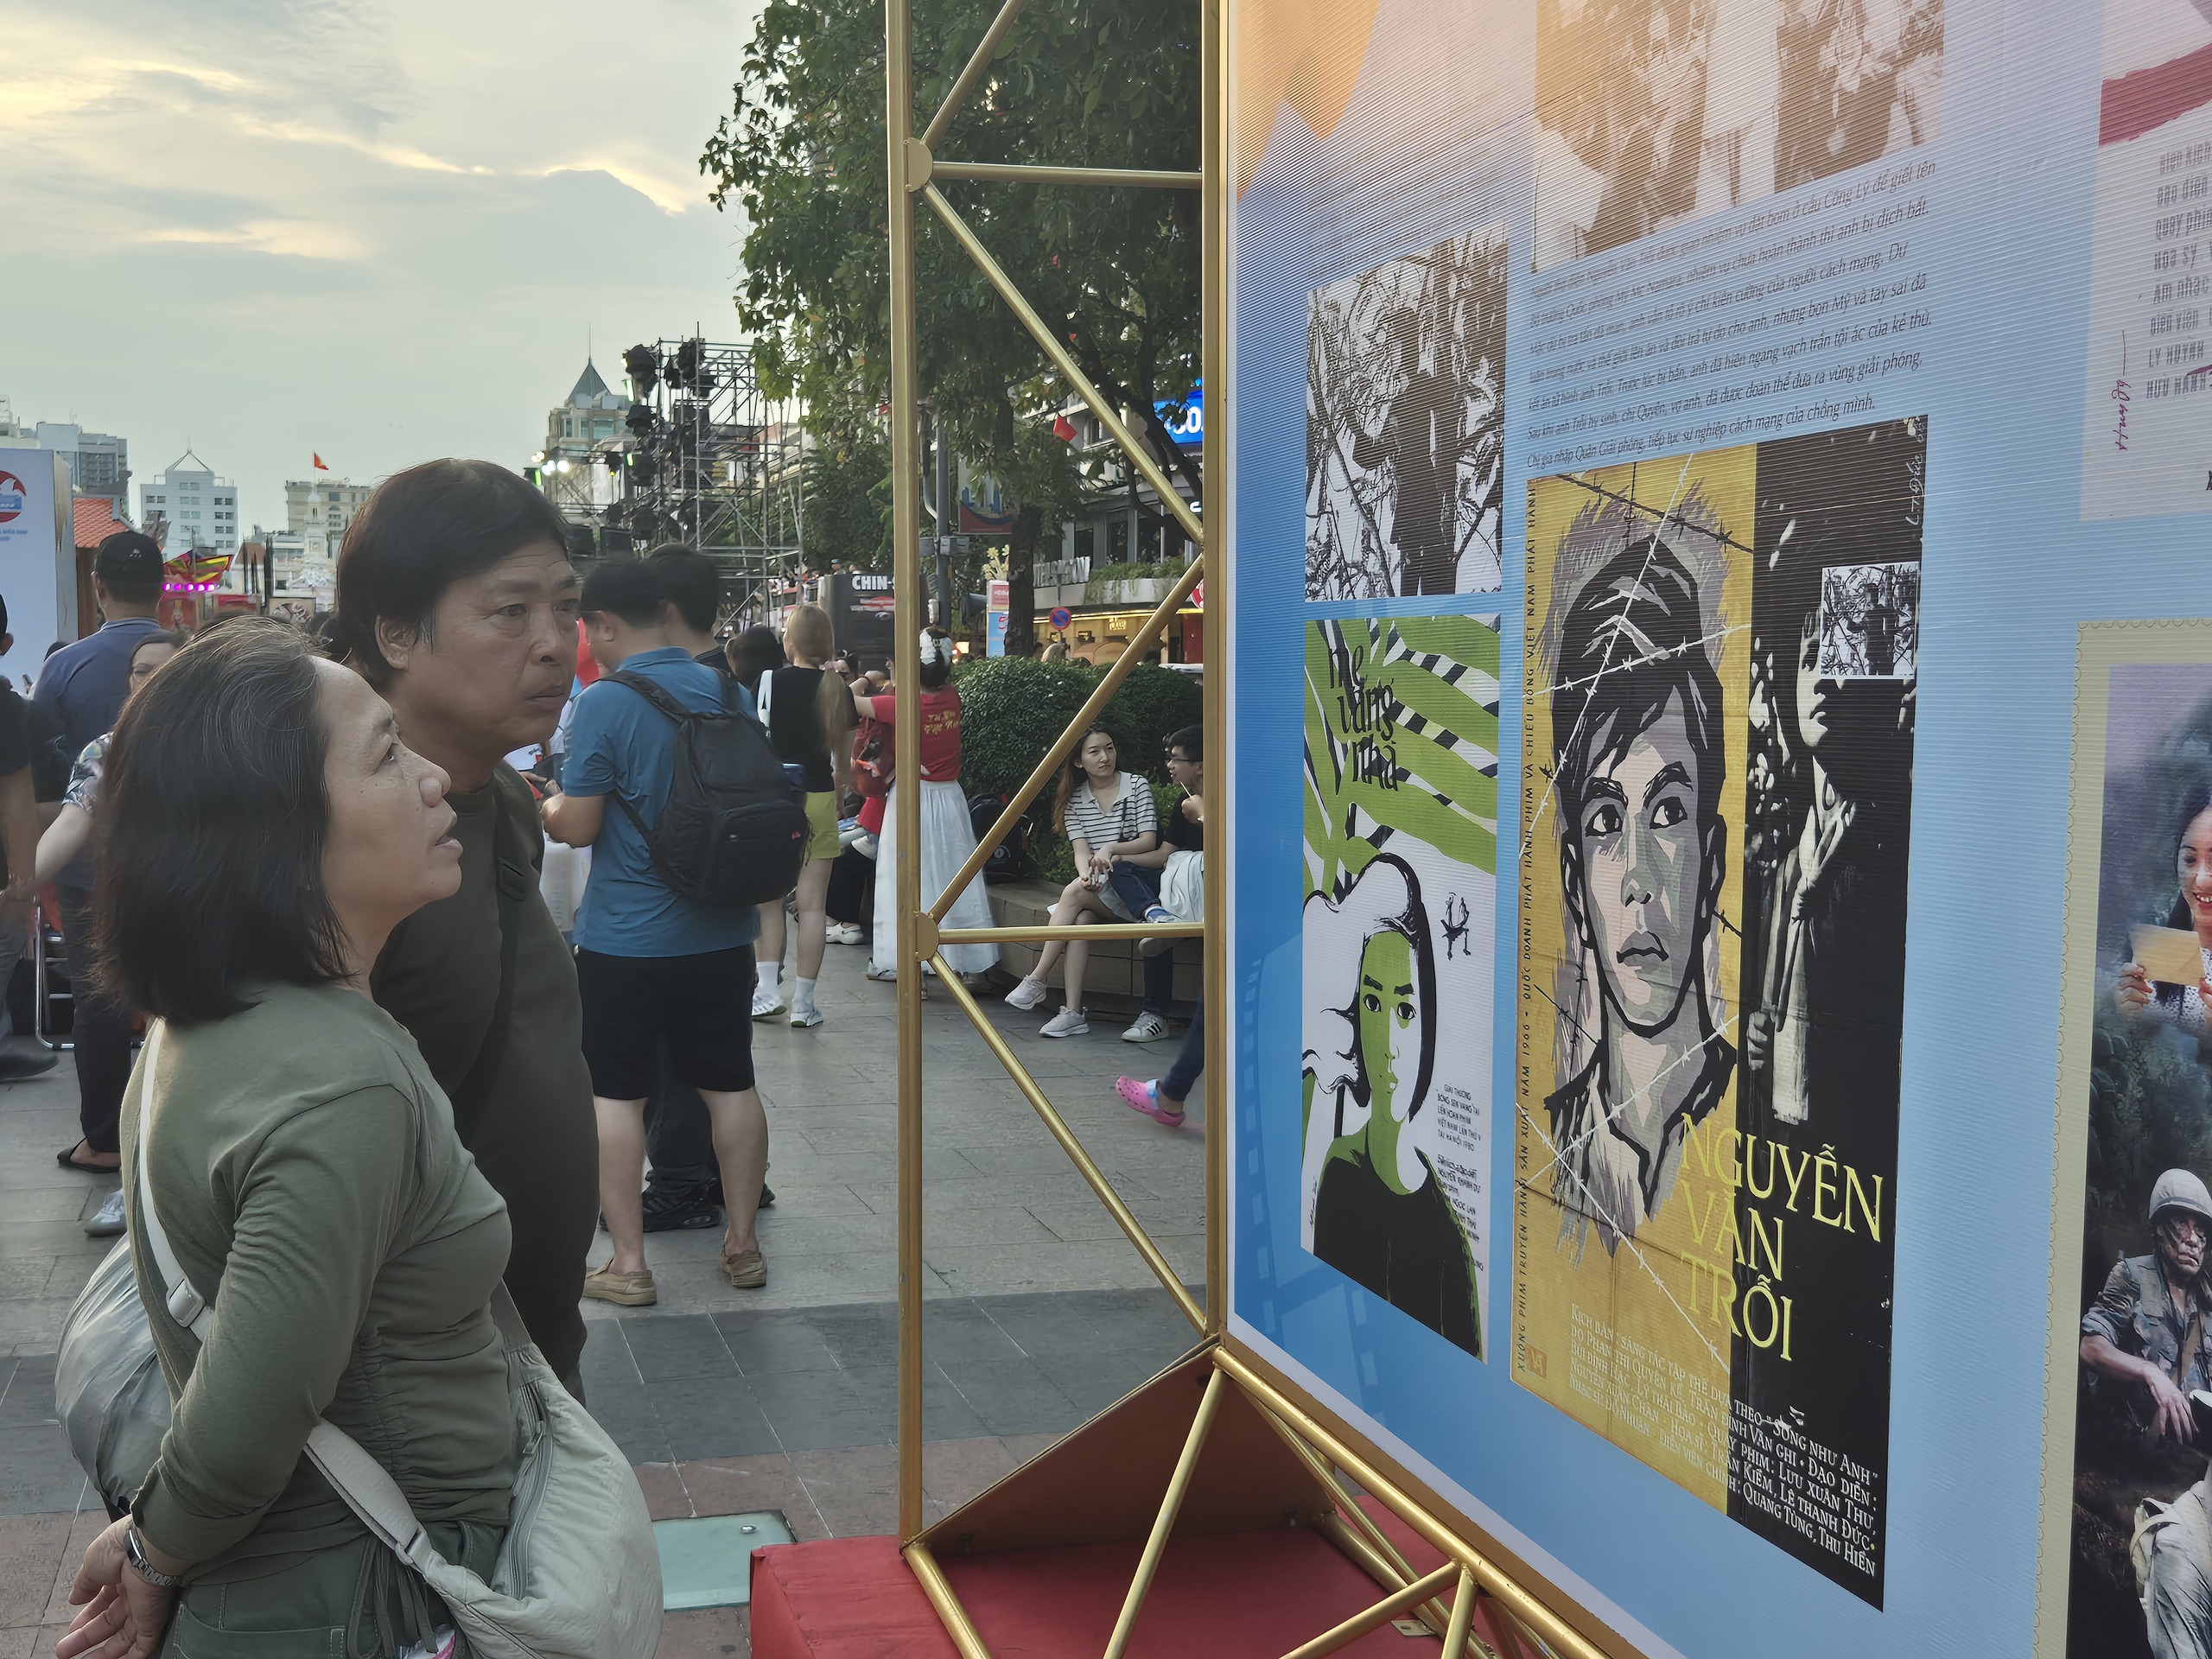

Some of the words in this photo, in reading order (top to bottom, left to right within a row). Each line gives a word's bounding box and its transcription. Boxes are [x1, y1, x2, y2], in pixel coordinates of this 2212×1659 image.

[1748, 348, 1778, 368] ngang
[1869, 318, 1888, 339] của
[1829, 365, 1854, 383] vùng
[1858, 356, 1880, 381] giải
[1730, 415, 1751, 434] cách
[1756, 414, 1783, 430] mạng
[1786, 407, 1804, 423] của
[1807, 399, 1840, 421] chồng
[852, 575, 894, 590] CHIN-
[1526, 584, 1535, 616] NAM
[1524, 787, 1533, 823] PHIM
[1522, 918, 1531, 960] DOANH
[1522, 1024, 1530, 1056] 1966
[1680, 1112, 1885, 1243] NGUYỄN
[1679, 1178, 1785, 1281] VĂN
[1518, 1283, 1527, 1318] PHIM
[1679, 1253, 1794, 1362] TRỖI
[1735, 1399, 1763, 1426] THEO
[1808, 1440, 1838, 1466] NHƯ
[1776, 1444, 1796, 1467] GHI
[1780, 1483, 1795, 1507] LÊ
[1798, 1496, 1838, 1533] THANH
[1807, 1480, 1840, 1511] XUÂN
[1743, 1483, 1782, 1519] QUANG
[1819, 1526, 1840, 1554] THU
